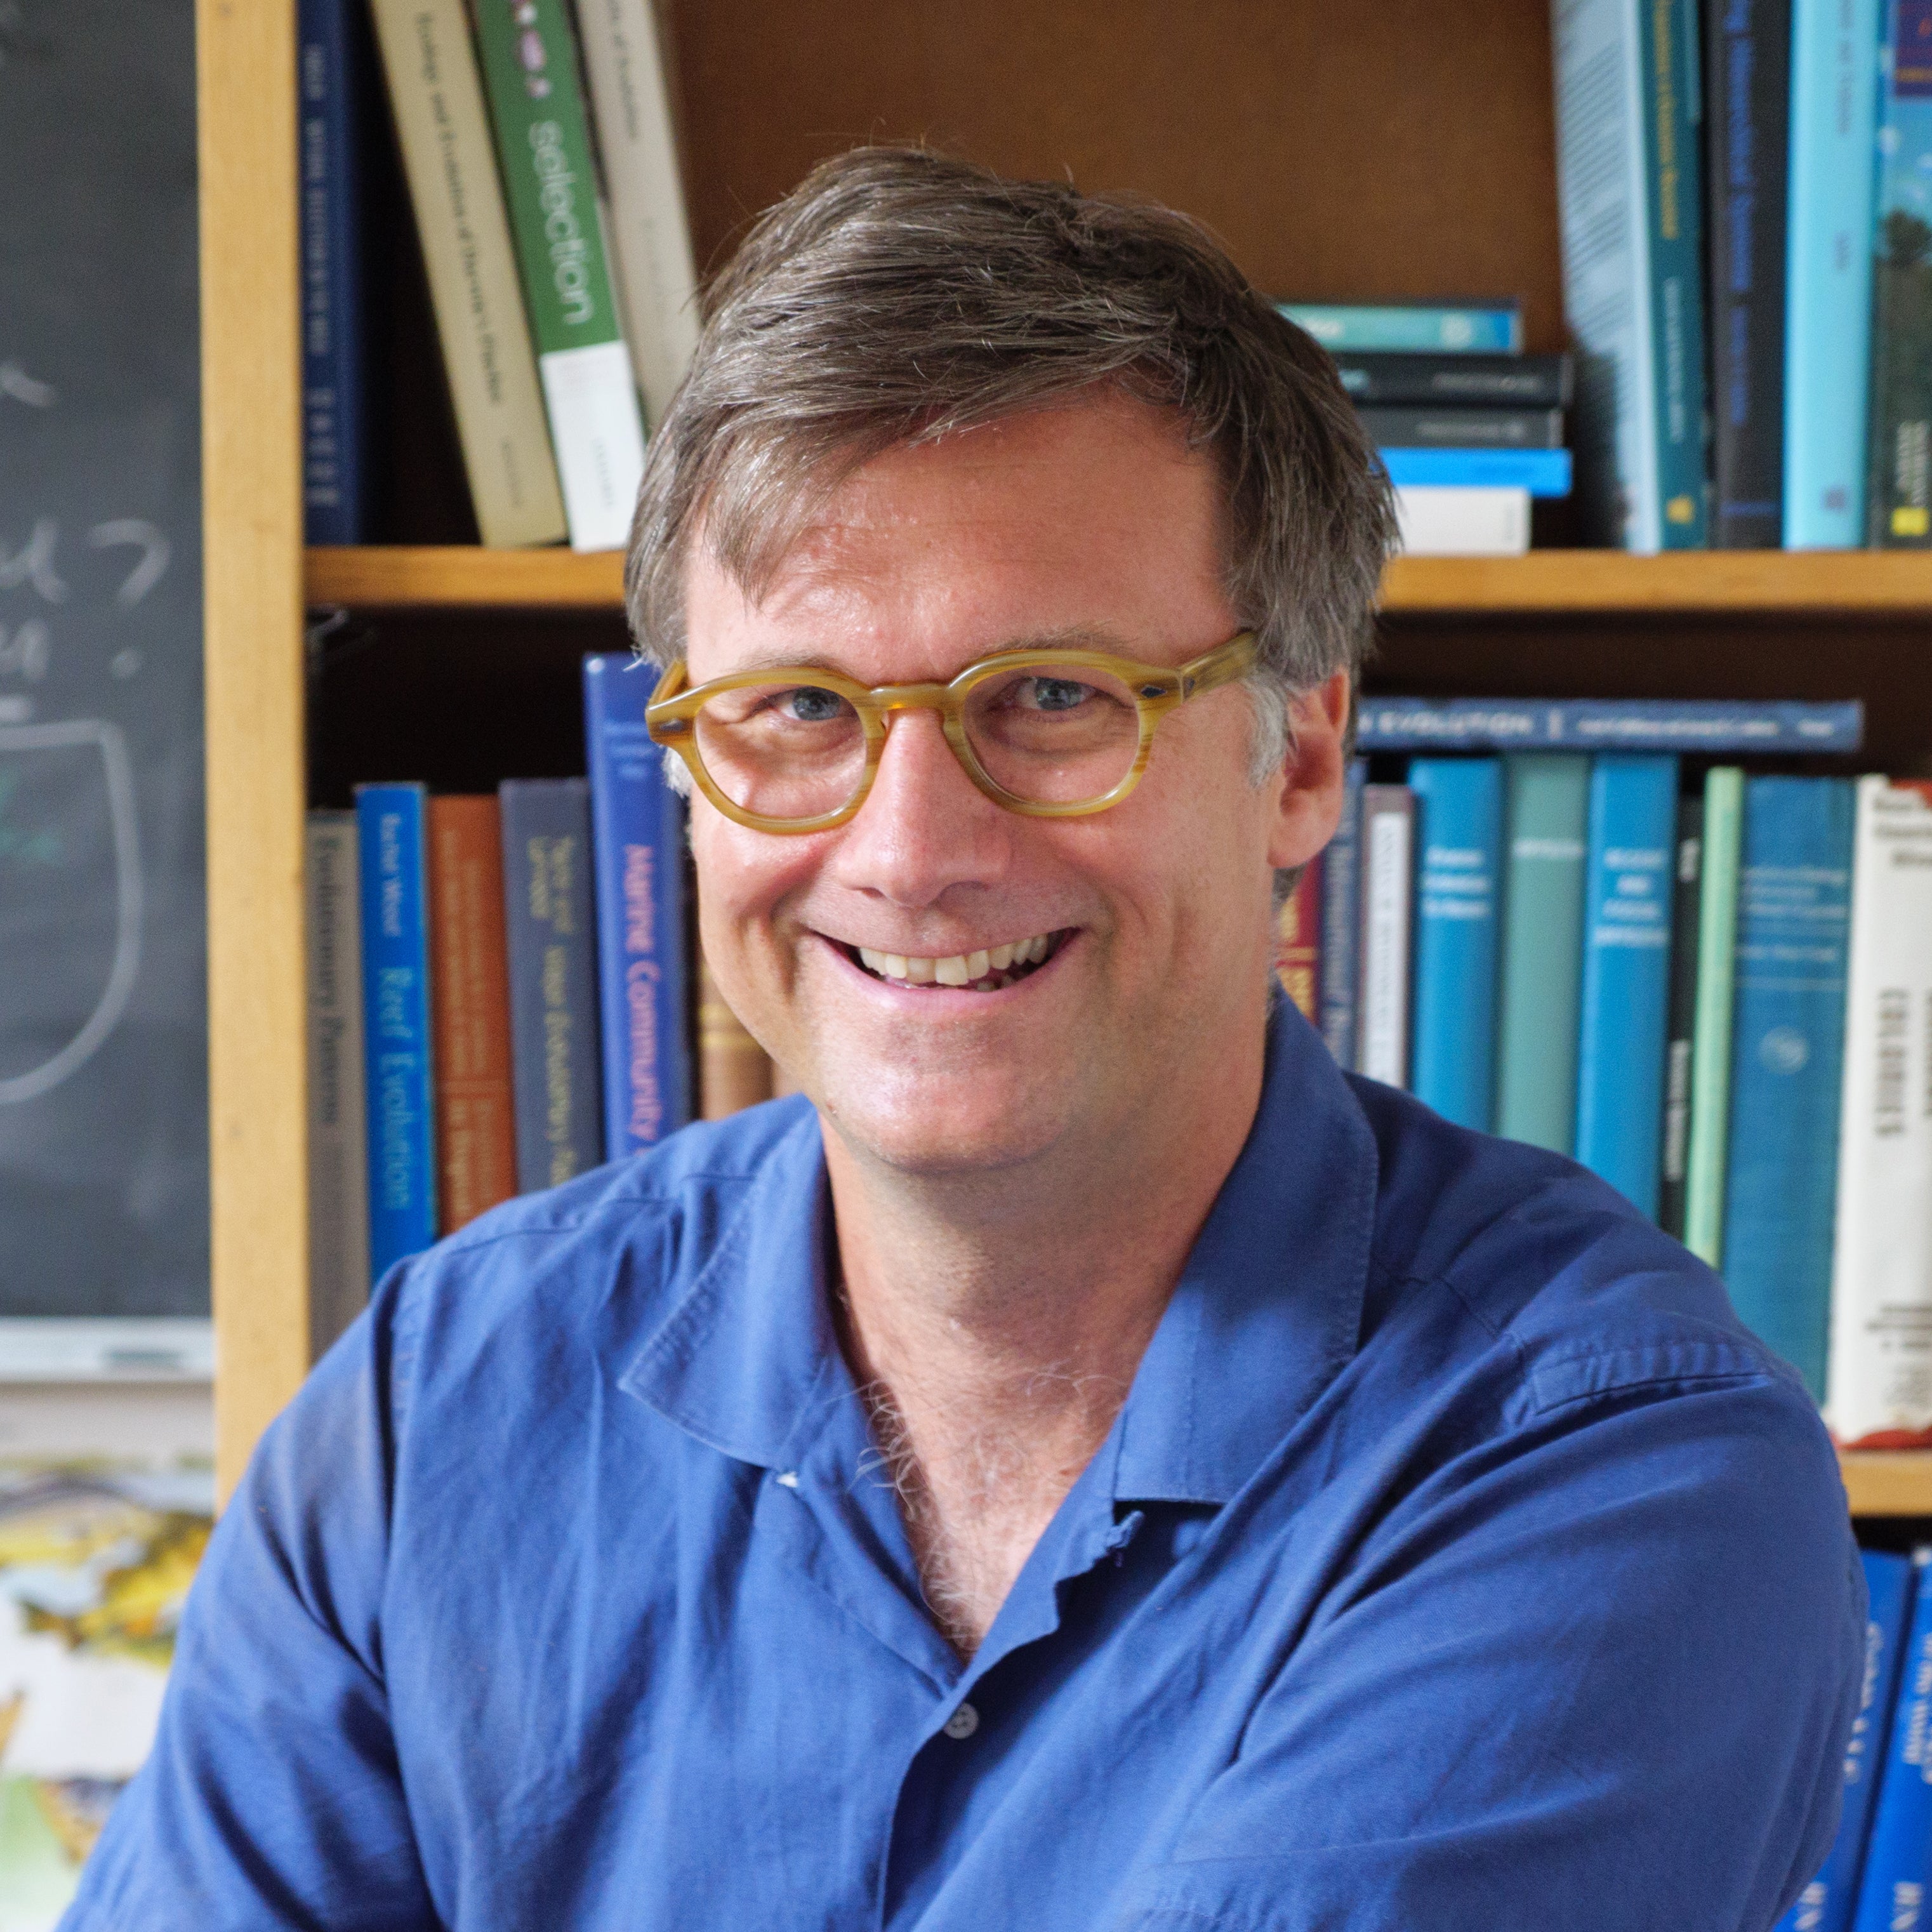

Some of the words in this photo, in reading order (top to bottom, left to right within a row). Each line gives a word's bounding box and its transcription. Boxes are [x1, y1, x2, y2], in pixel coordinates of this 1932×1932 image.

[437, 131, 472, 218] Evolution
[527, 121, 601, 326] selection
[1377, 710, 1534, 736] EVOLUTION
[313, 837, 342, 1009] Evolutionary
[623, 844, 656, 953] Marine
[378, 966, 414, 1040] Reef
[626, 960, 664, 1141] Community
[1877, 988, 1910, 1139] COLONIES
[318, 1016, 344, 1124] Patterns
[379, 1052, 414, 1209] Evolution
